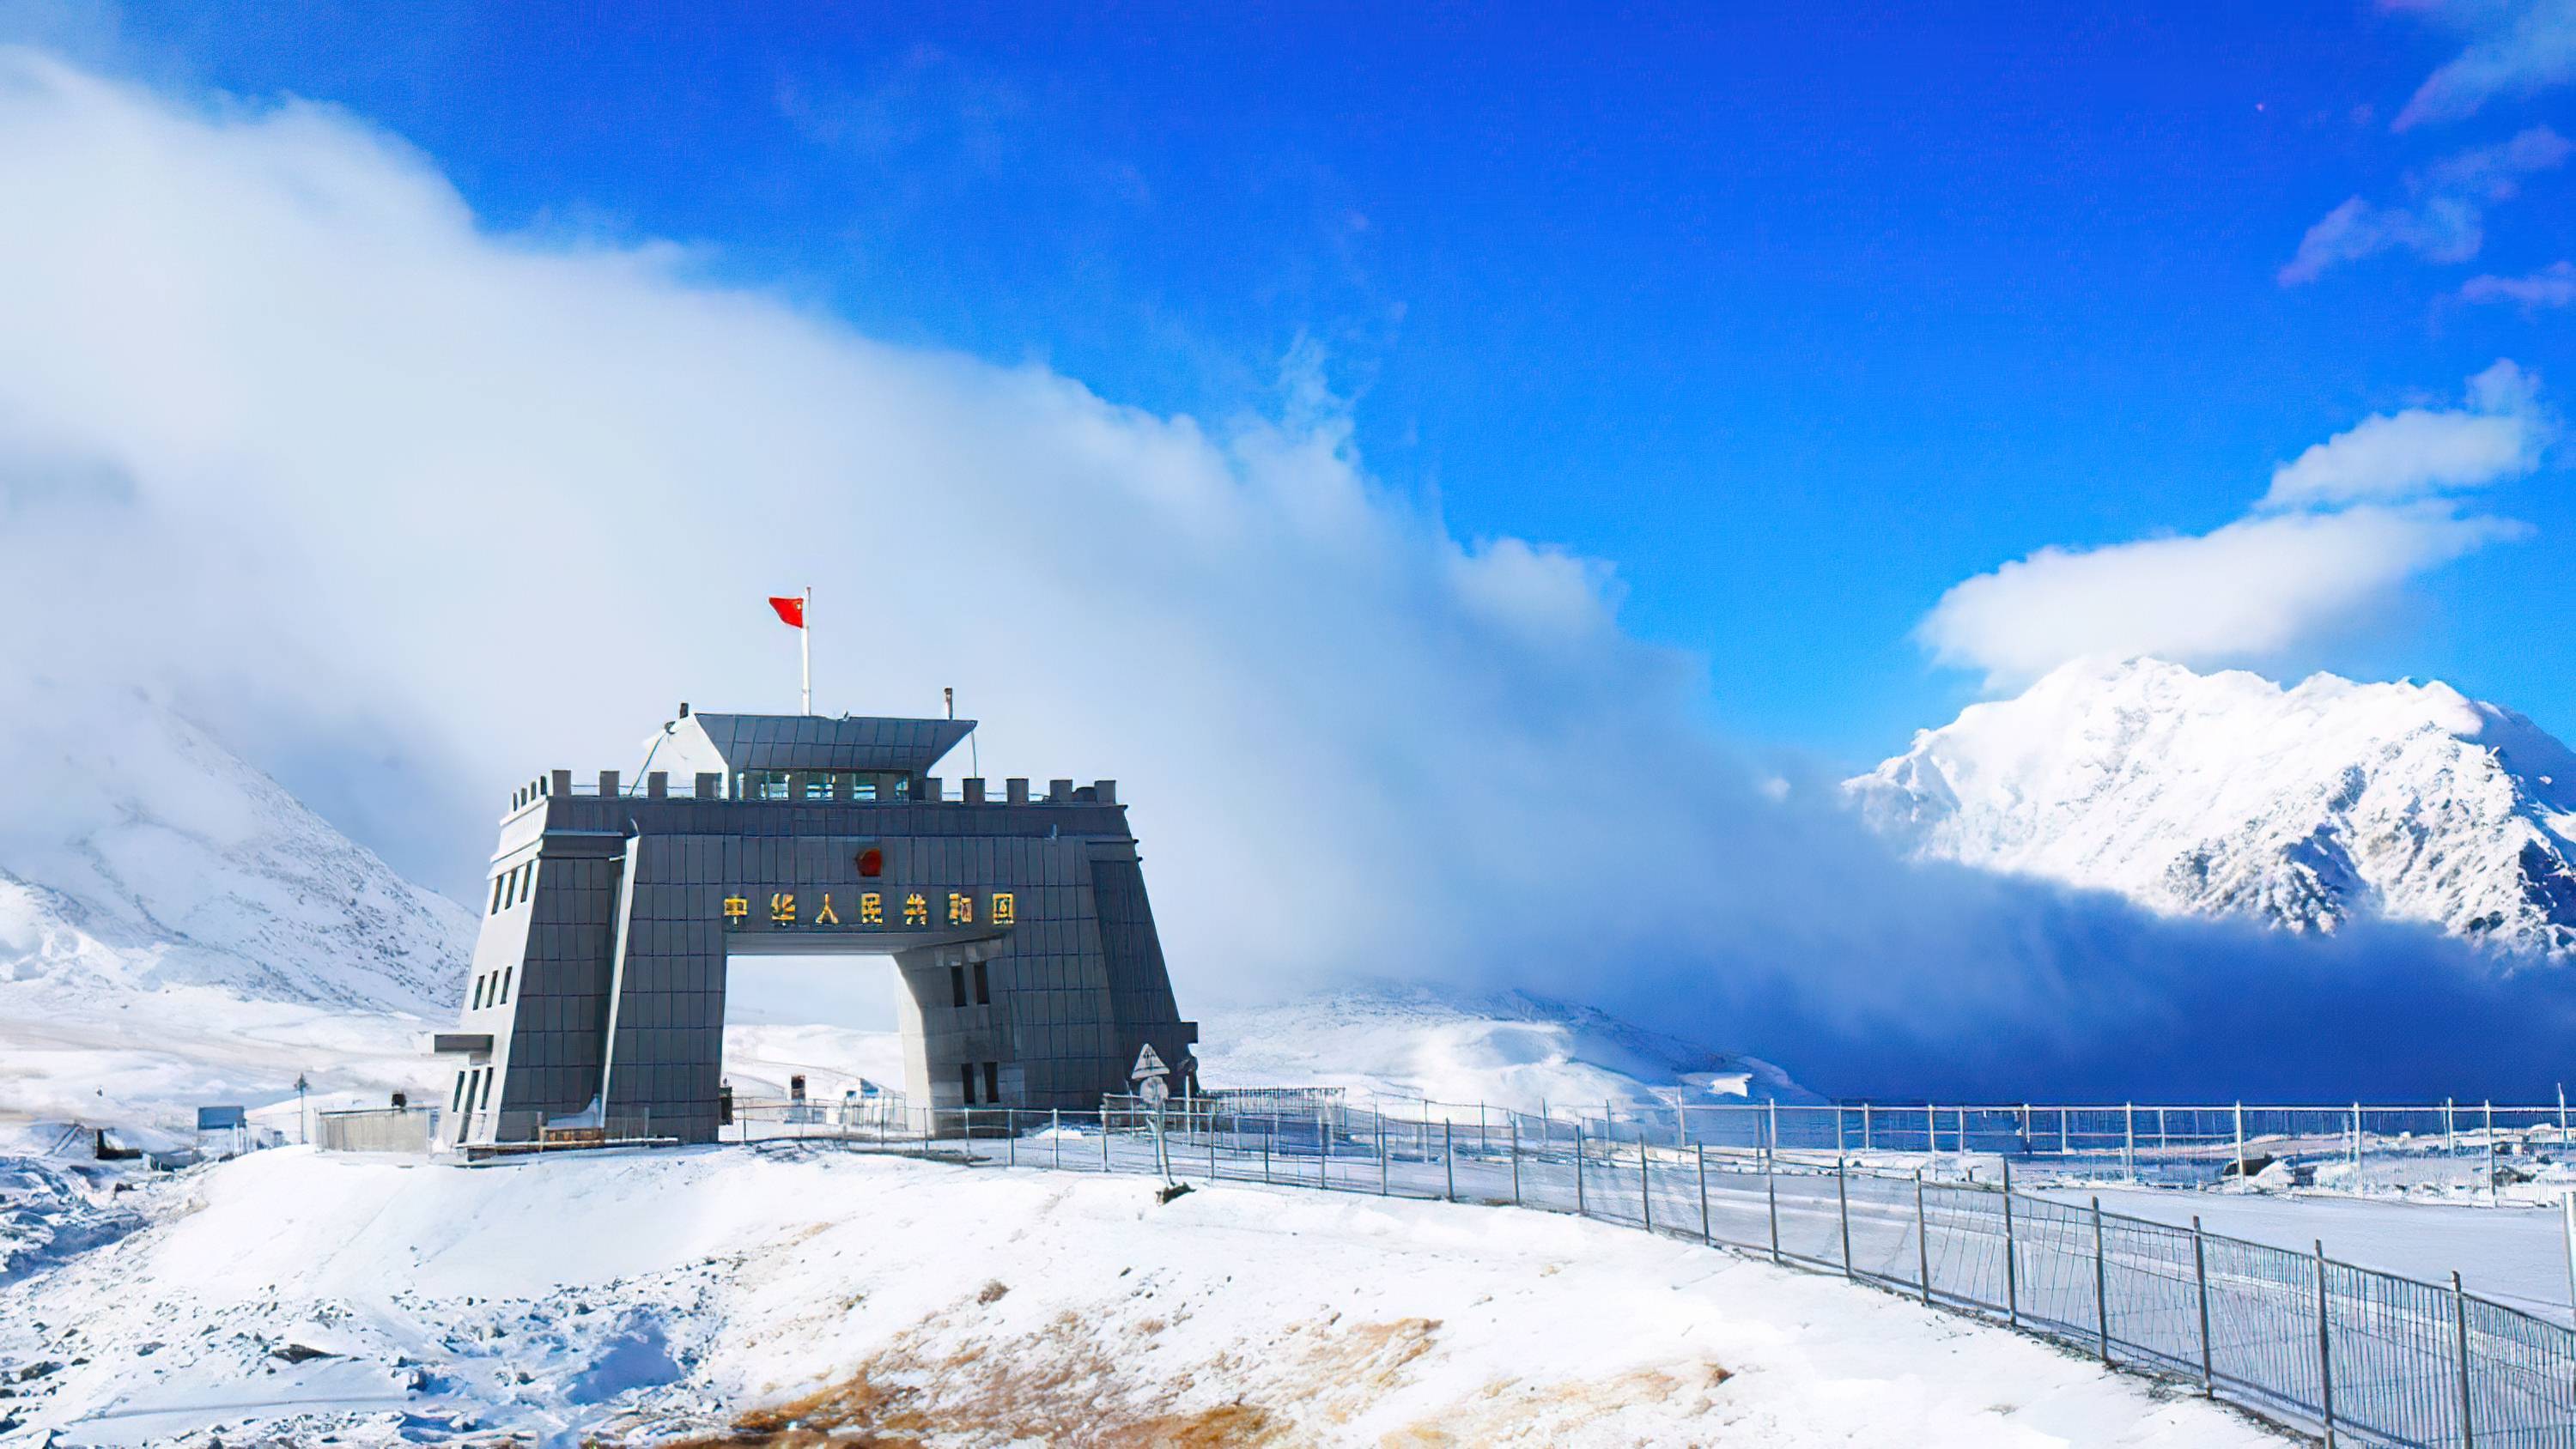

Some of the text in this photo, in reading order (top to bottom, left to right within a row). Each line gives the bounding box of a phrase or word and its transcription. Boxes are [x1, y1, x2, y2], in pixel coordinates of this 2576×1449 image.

[723, 892, 1016, 927] 中华人民共和国
